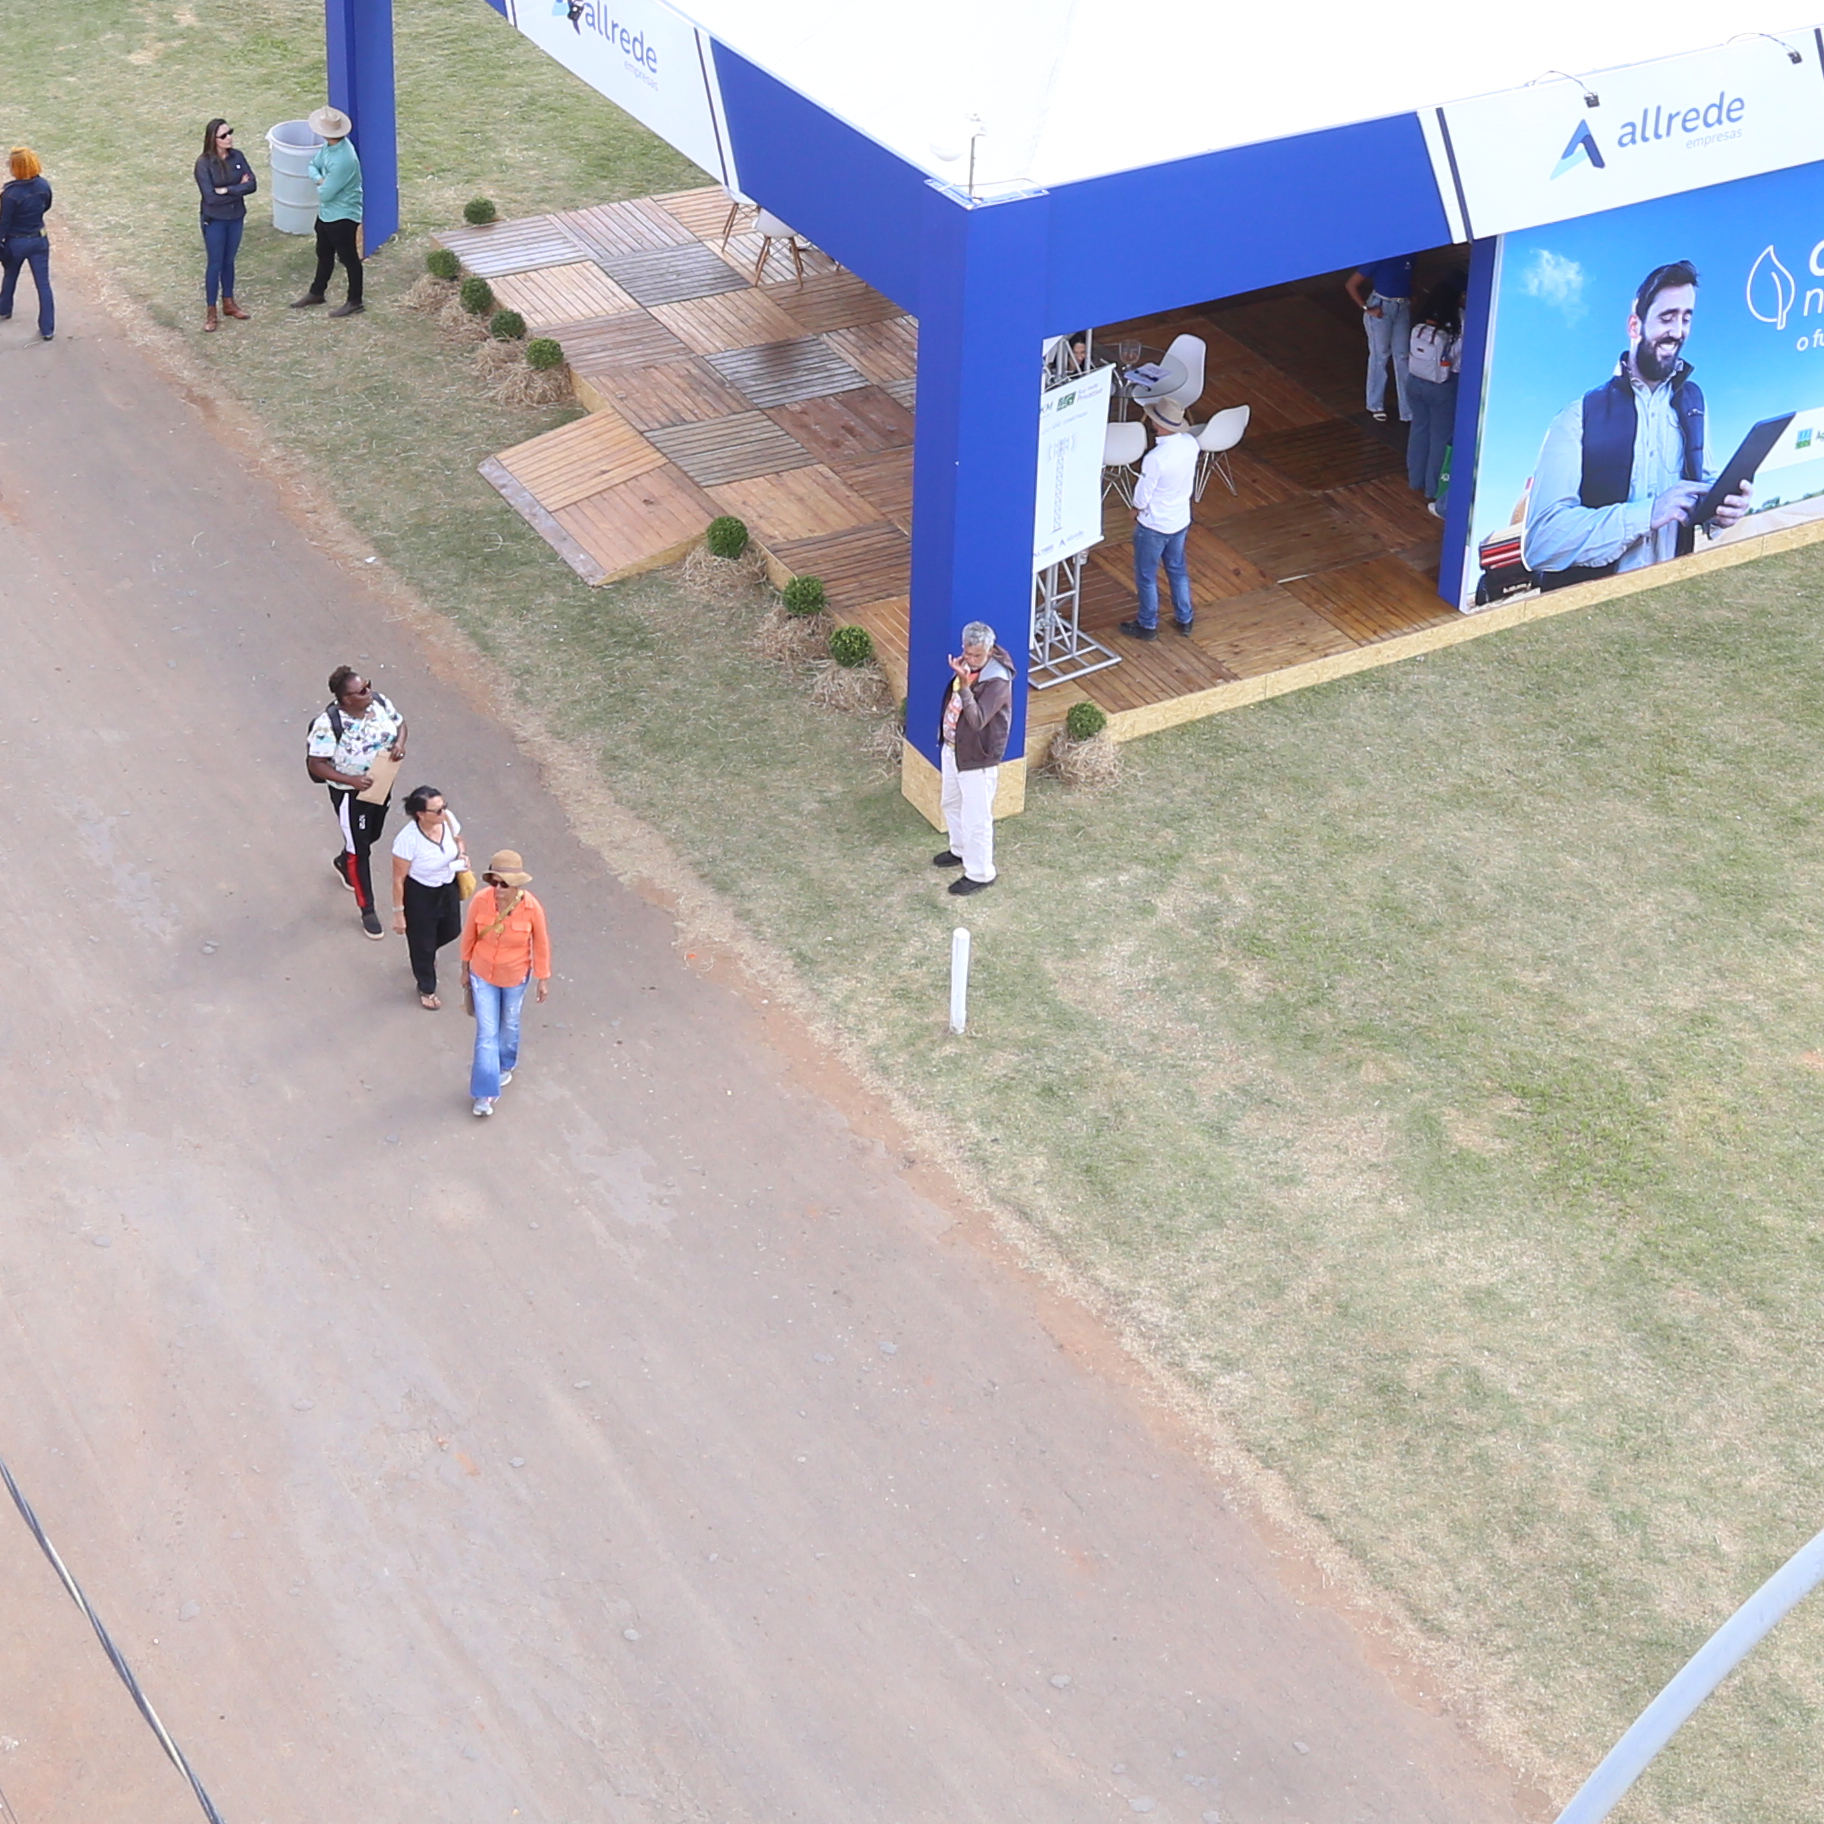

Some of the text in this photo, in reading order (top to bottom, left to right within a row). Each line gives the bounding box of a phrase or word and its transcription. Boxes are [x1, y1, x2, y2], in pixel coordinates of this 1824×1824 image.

[1617, 91, 1745, 148] allrede
[1685, 128, 1743, 149] empresas
[1796, 336, 1809, 352] o
